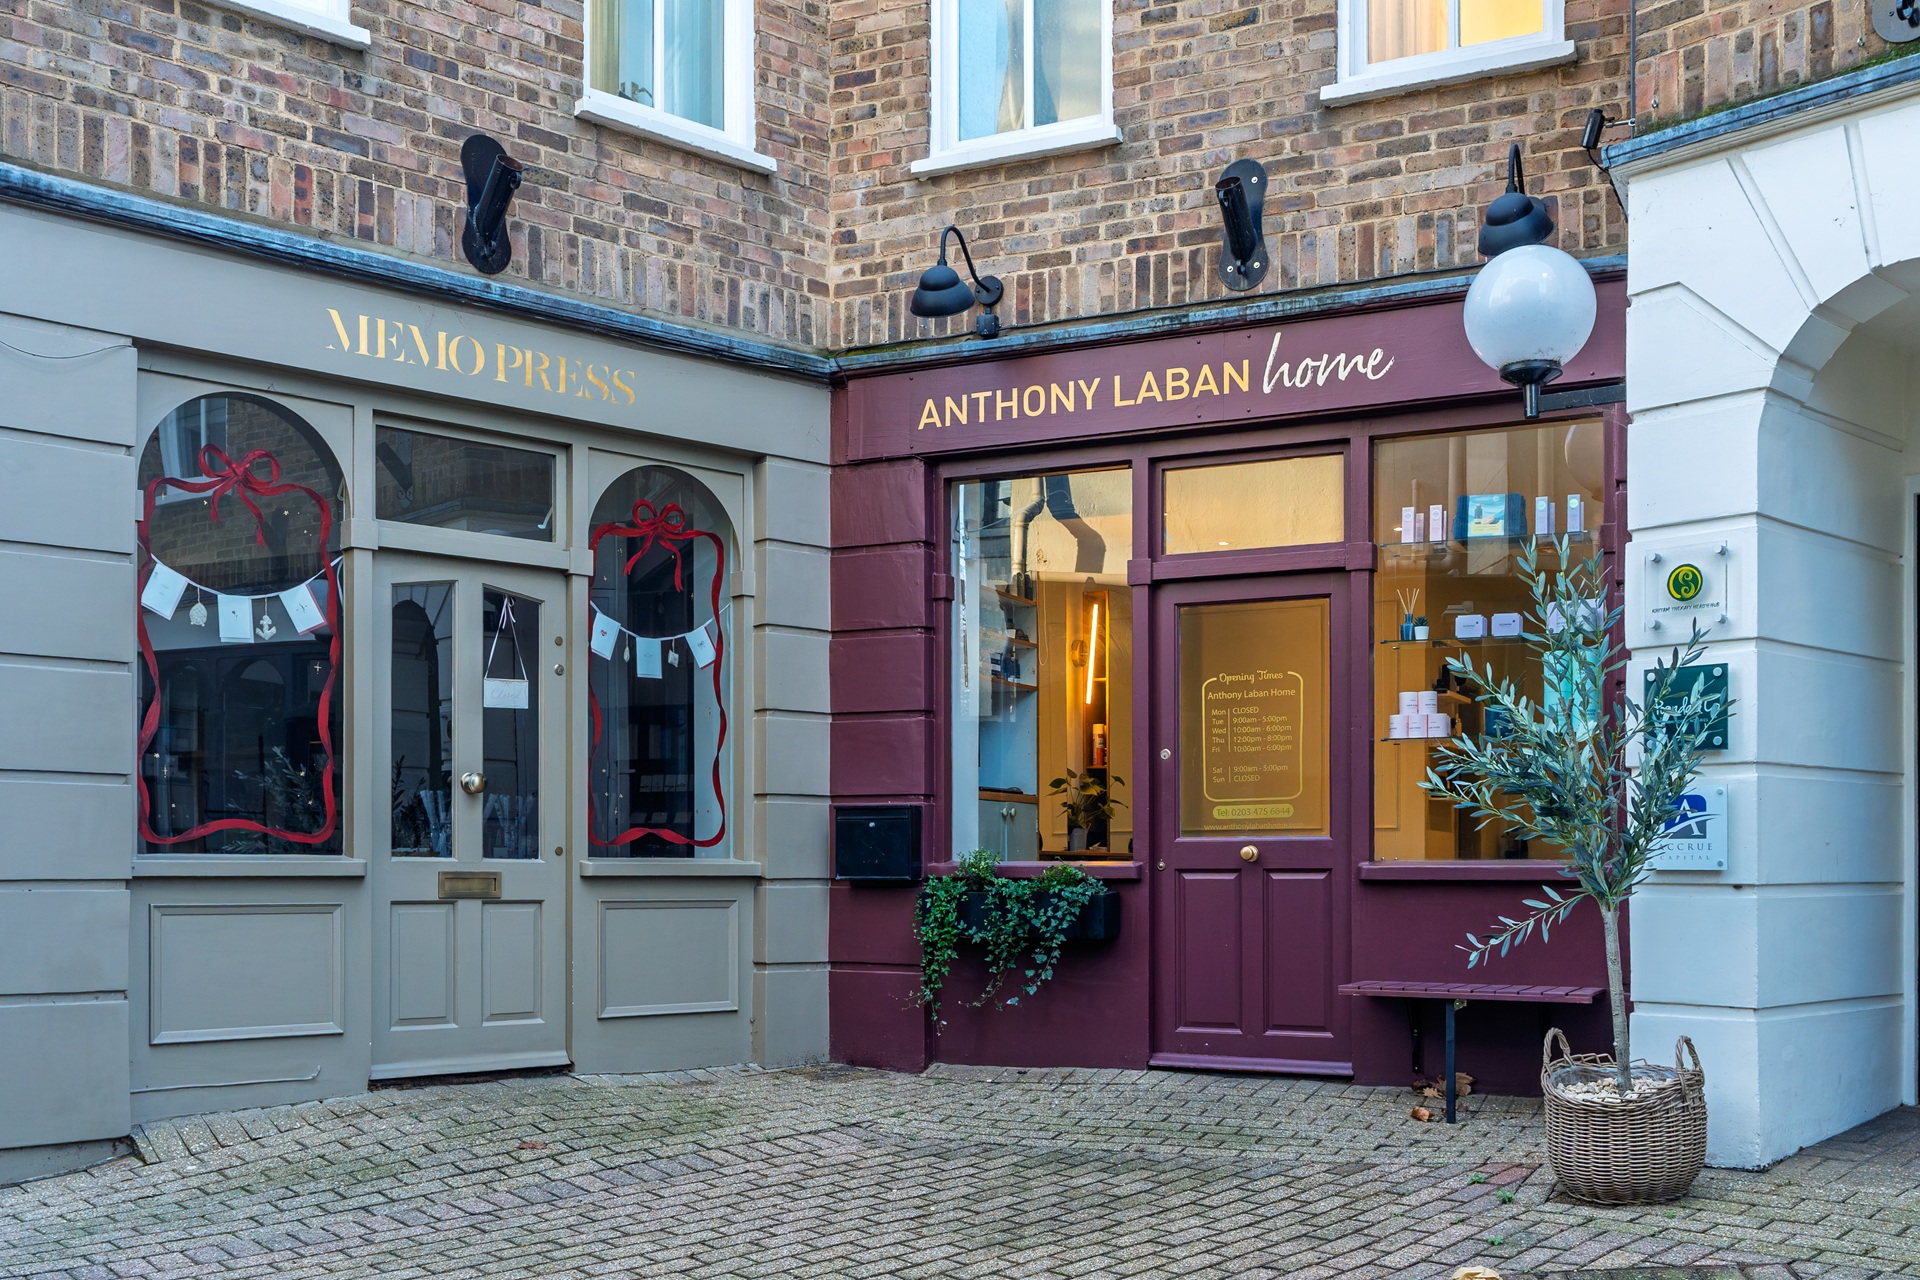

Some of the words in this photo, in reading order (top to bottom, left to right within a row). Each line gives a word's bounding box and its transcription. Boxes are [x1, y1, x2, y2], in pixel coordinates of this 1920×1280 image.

[325, 308, 486, 376] MEMO
[492, 343, 636, 406] PRESS
[1262, 331, 1396, 395] home
[918, 377, 1101, 430] ANTHONY
[1114, 359, 1250, 407] LABAN
[1219, 673, 1255, 685] Opening
[1256, 669, 1284, 680] Times
[1207, 692, 1242, 700] Anthony
[1243, 689, 1269, 698] Laban
[1270, 688, 1296, 697] Home
[1232, 706, 1260, 715] CLOSED
[1262, 715, 1288, 723] 5:00pm
[1266, 725, 1292, 733] 6:00pm
[1233, 736, 1262, 744] 12:00pm
[1266, 744, 1292, 752] 6:00pm
[1233, 765, 1258, 773] 9:00am
[1263, 764, 1289, 772] 5:00pm
[1233, 774, 1261, 782] CLOSED
[1217, 809, 1230, 817] Tel:
[1231, 808, 1252, 817] 0203
[1253, 807, 1269, 815] 475
[1659, 842, 1713, 851] ACCRUE
